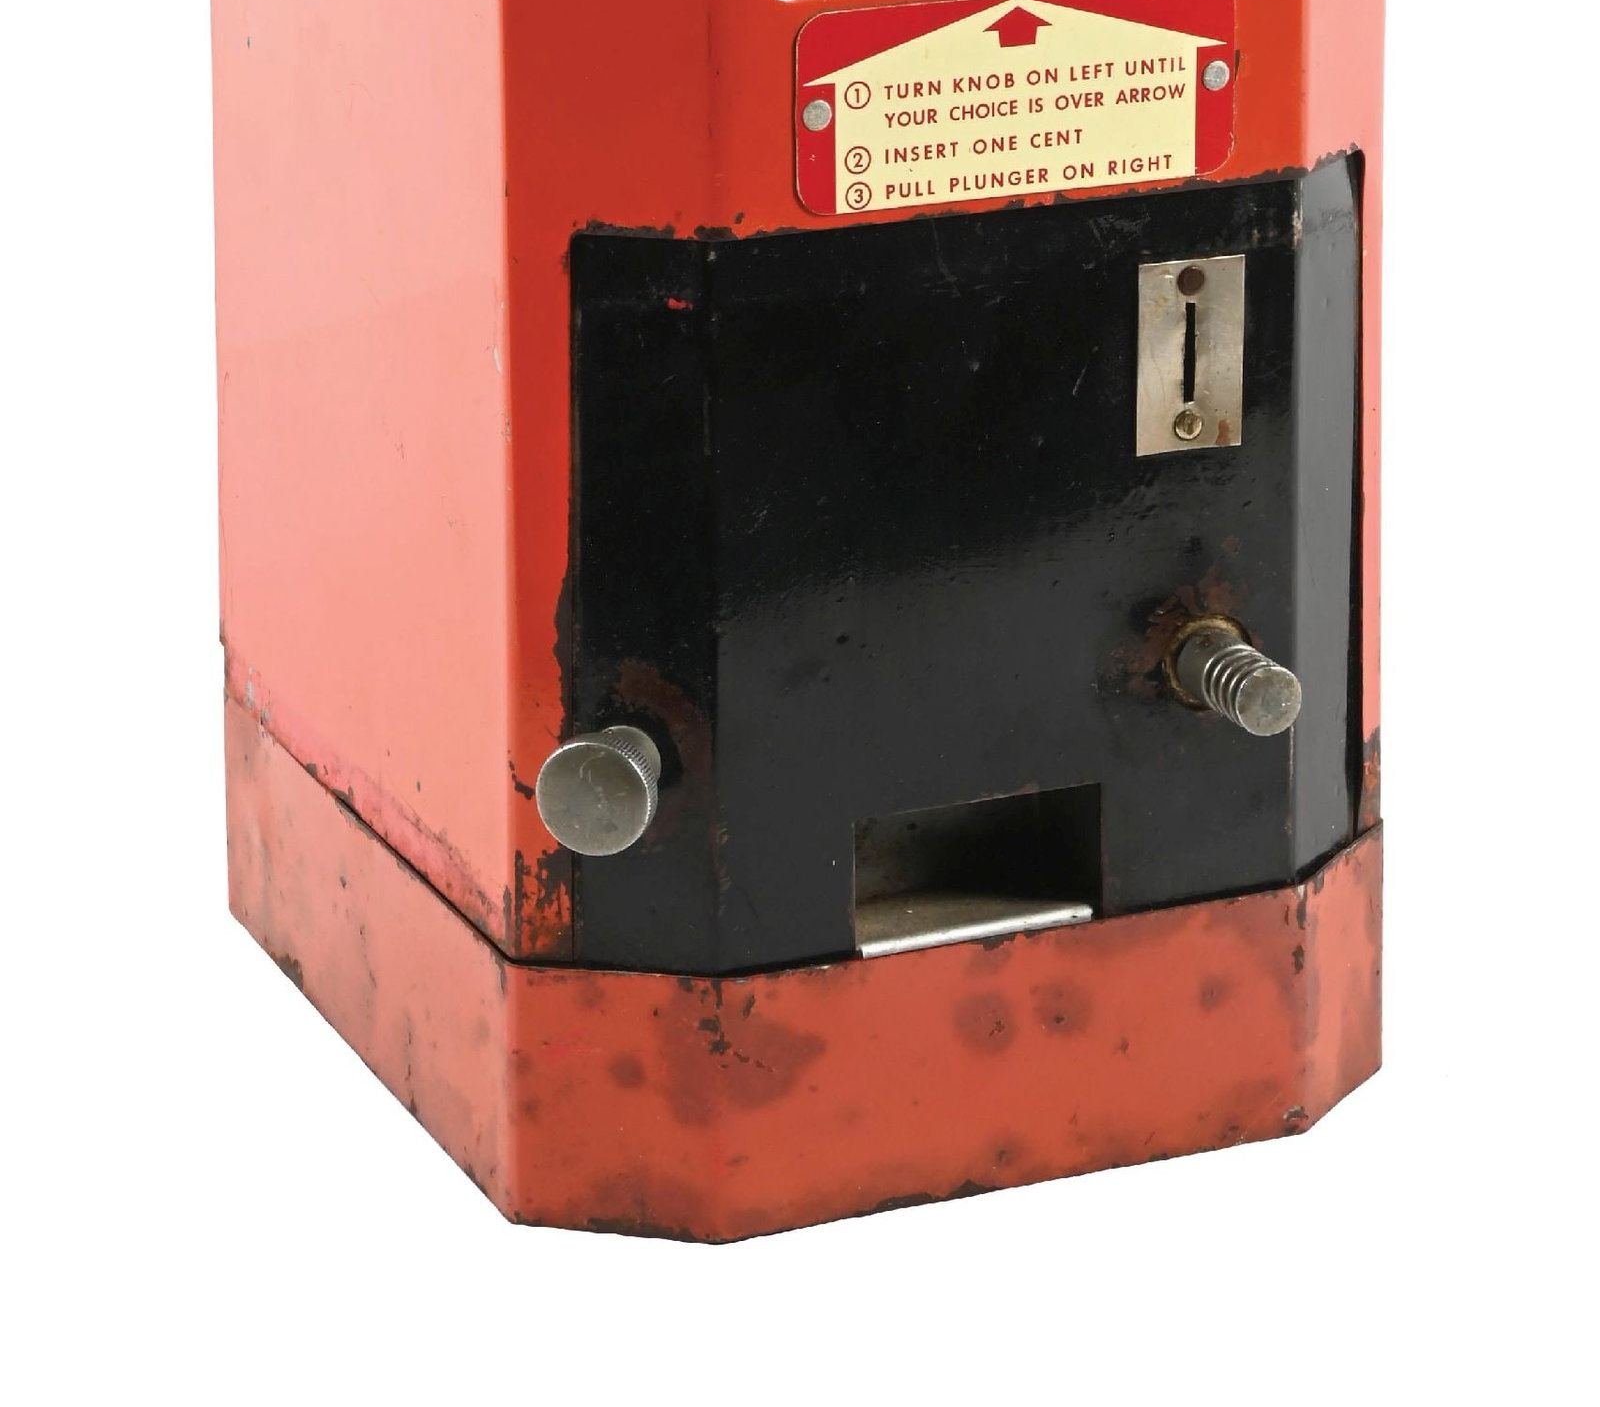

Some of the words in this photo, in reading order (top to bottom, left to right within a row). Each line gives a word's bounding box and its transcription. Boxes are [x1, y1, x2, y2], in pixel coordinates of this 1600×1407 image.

[884, 80, 942, 100] TURN
[952, 73, 1015, 94] KNOB
[1026, 68, 1058, 86] ON
[1070, 62, 1114, 82] LEFT
[1125, 56, 1186, 76] UNTIL
[884, 108, 938, 129] YOUR
[949, 100, 1018, 121] CHOICE
[1028, 97, 1044, 114] IS
[1055, 91, 1104, 111] OVER
[1115, 83, 1186, 105] ARROW
[884, 141, 959, 165] INSERT
[972, 135, 1018, 155] ONE
[1030, 128, 1083, 149] CENT
[885, 180, 936, 200] PULL
[949, 168, 1050, 193] PLUNGER
[1062, 162, 1095, 181] ON
[1107, 154, 1173, 176] RIGHT
